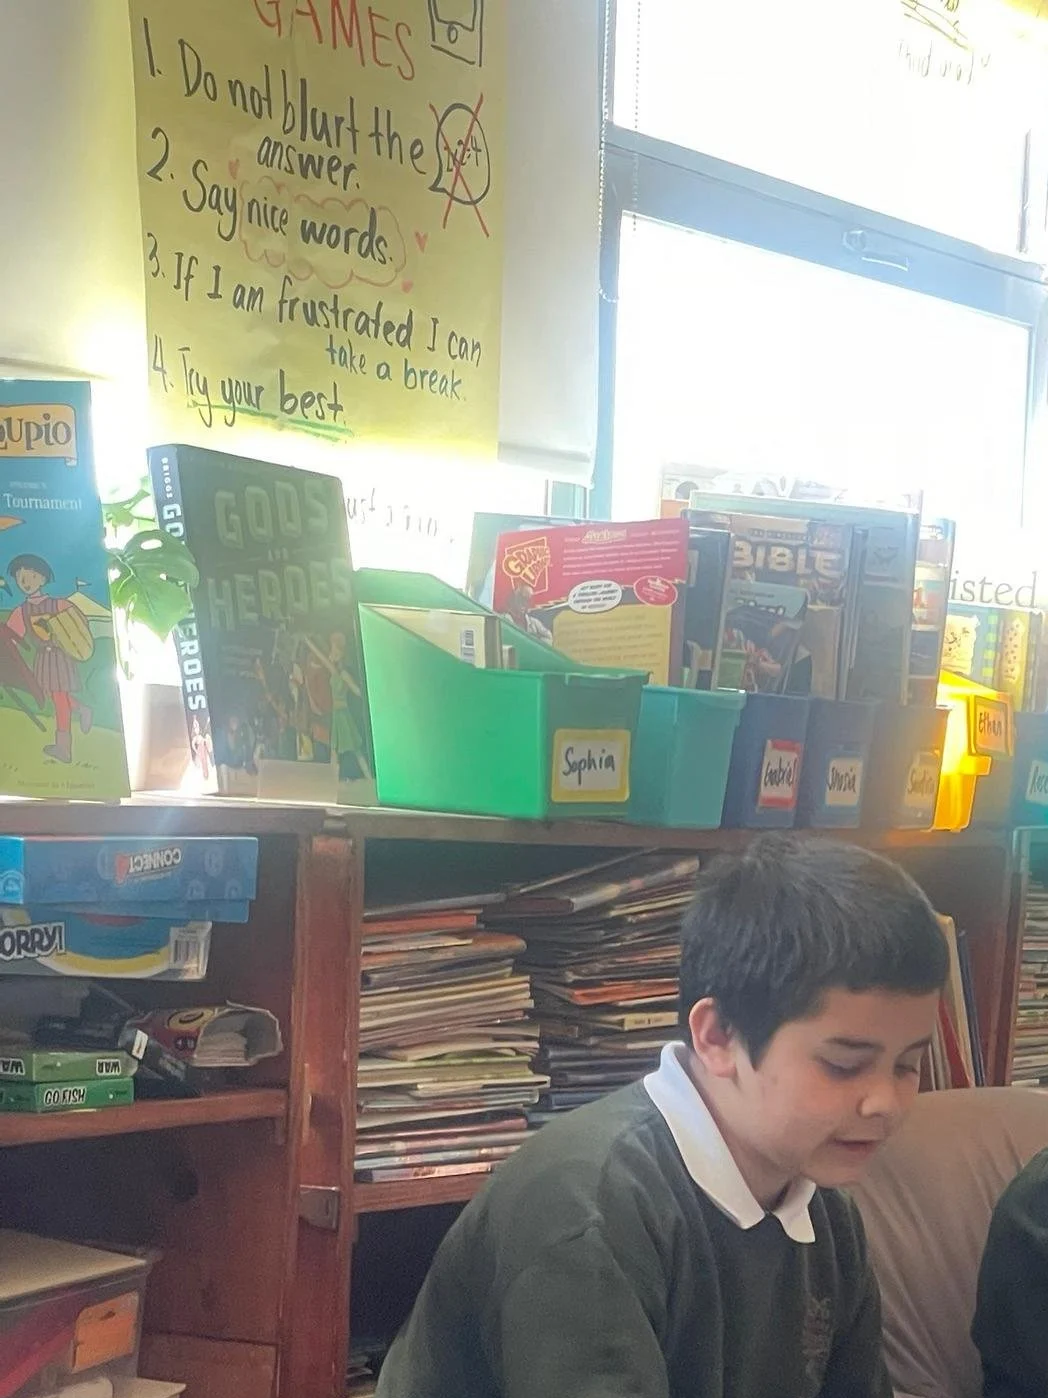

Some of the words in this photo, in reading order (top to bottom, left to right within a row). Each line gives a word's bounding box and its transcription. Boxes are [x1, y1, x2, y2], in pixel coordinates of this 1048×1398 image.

[253, 0, 415, 80] GAMES
[143, 17, 162, 77] 1.
[178, 38, 217, 101] Do
[228, 64, 272, 119] not
[281, 69, 359, 154] blurt
[368, 107, 427, 174] the
[257, 136, 360, 191] answer.
[147, 126, 174, 182] 2.
[182, 159, 237, 242] Say
[247, 196, 288, 236] nice
[301, 206, 393, 265] words.
[147, 232, 166, 278] 3.
[173, 252, 199, 301] If
[207, 264, 222, 299] I
[232, 283, 264, 312] am
[278, 274, 413, 351] frustrated
[427, 317, 439, 352] I
[448, 331, 481, 367] can
[150, 334, 174, 393] 4.
[178, 347, 212, 428] Try
[221, 376, 265, 427] your
[325, 334, 367, 374] take
[376, 362, 392, 381] a
[3, 493, 82, 511] Tournament
[213, 479, 329, 549] GODS
[733, 539, 844, 580] BIBLE
[206, 556, 351, 633] HEROES
[562, 746, 616, 785] Sophia
[128, 847, 182, 873] CONNECT
[97, 1060, 121, 1074] WAR
[44, 1089, 61, 1106] GO
[61, 1087, 86, 1103] FISH
